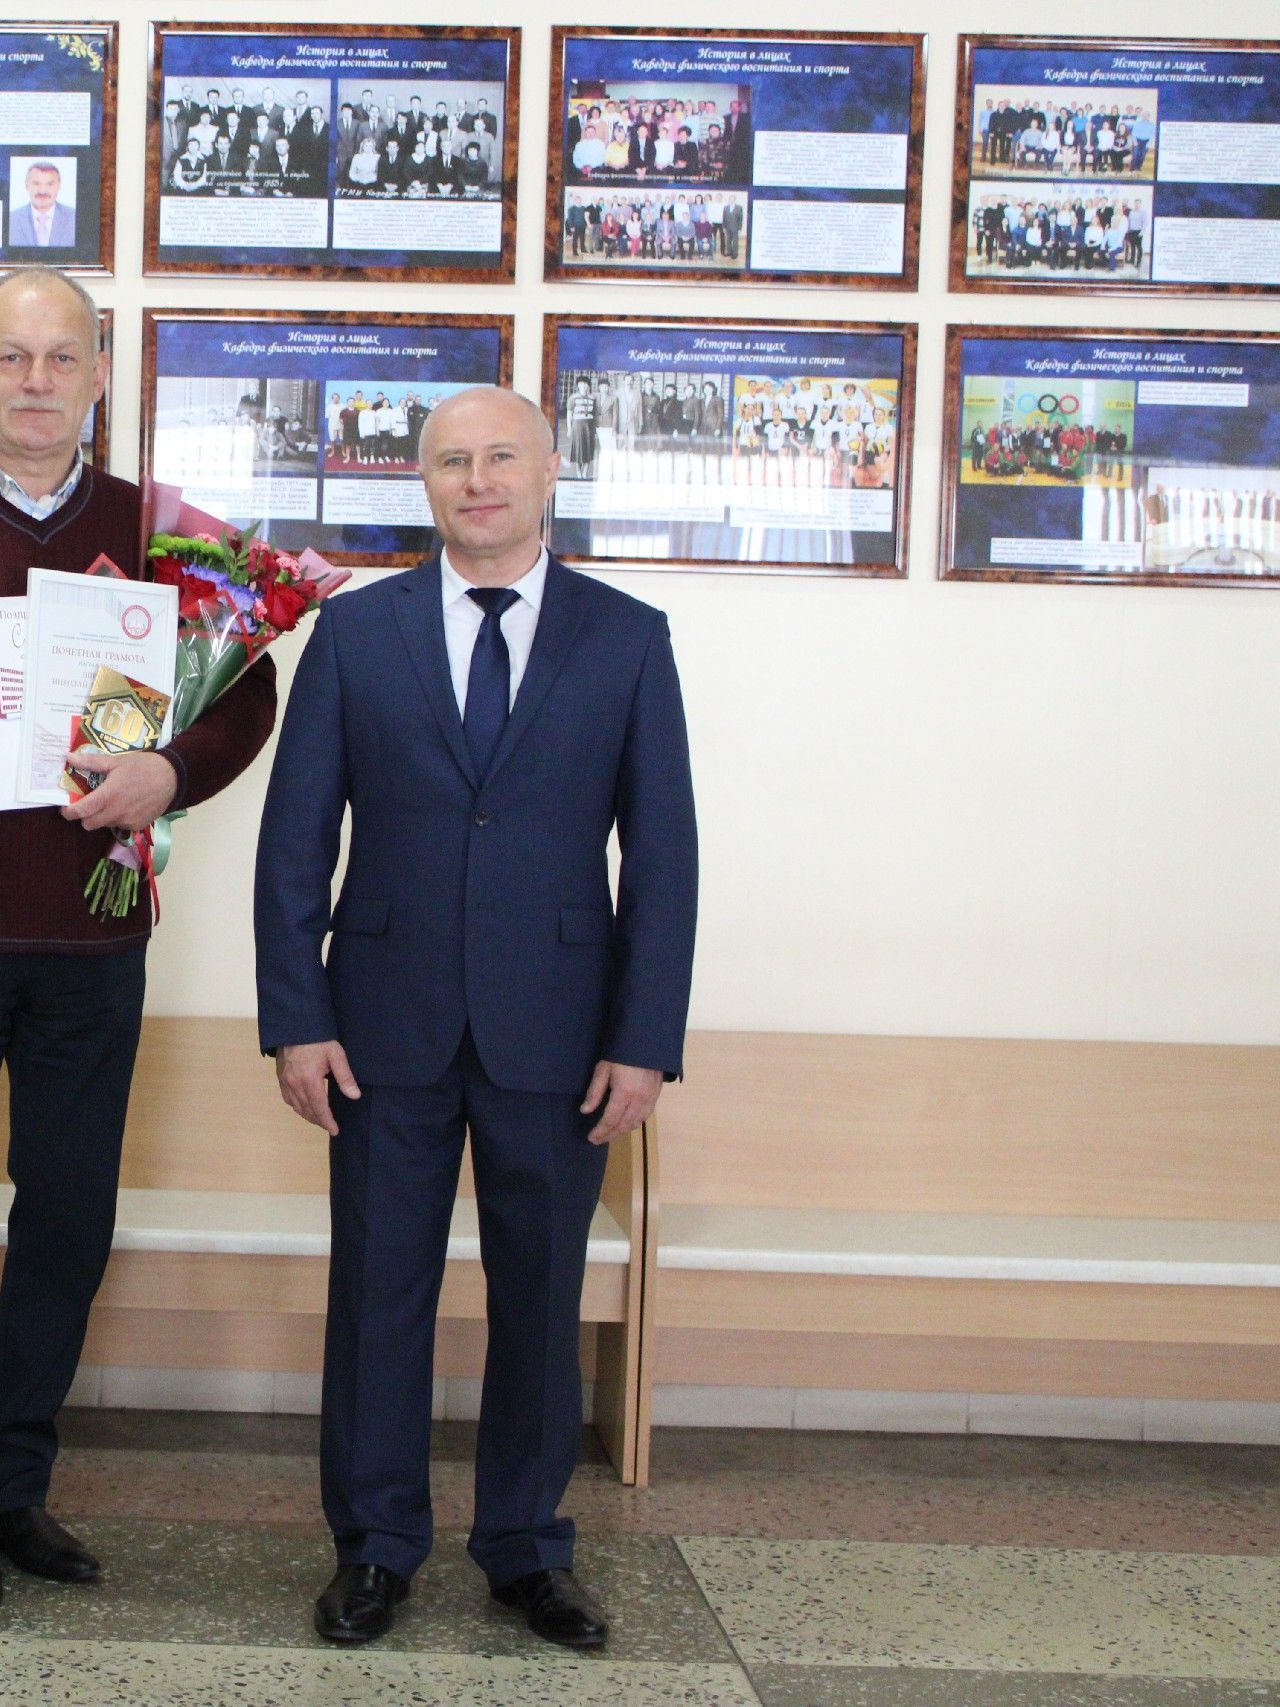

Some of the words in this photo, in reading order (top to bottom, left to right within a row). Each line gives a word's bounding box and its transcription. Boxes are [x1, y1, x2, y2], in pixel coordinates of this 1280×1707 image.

[0, 53, 6, 62] и
[8, 53, 45, 64] спорта
[296, 44, 345, 57] История
[347, 47, 353, 56] в
[355, 47, 389, 58] лицах
[697, 47, 746, 61] История
[749, 51, 755, 60] в
[757, 51, 791, 63] лицах
[230, 55, 274, 69] Кафедра
[276, 55, 338, 69] физического
[339, 58, 399, 68] воспитания
[402, 60, 408, 68] и
[410, 60, 448, 71] спорта
[632, 58, 676, 72] Кафедра
[677, 58, 740, 73] физического
[741, 63, 802, 73] воспитания
[804, 65, 811, 73] и
[813, 64, 849, 76] спорта
[1112, 57, 1161, 71] История
[1164, 60, 1170, 69] в
[1172, 60, 1207, 72] лицах
[1044, 68, 1088, 81] Кафедра
[1090, 70, 1152, 84] физического
[1154, 73, 1215, 83] воспитания
[1218, 74, 1224, 83] и
[1227, 74, 1264, 86] спорта
[287, 331, 336, 345] История
[339, 334, 344, 342] в
[346, 334, 380, 345] лицах
[693, 337, 742, 352] История
[745, 341, 750, 350] в
[753, 341, 787, 353] лицах
[222, 341, 265, 355] Кафедра
[268, 342, 329, 355] физического
[330, 346, 391, 356] воспитания
[393, 347, 399, 356] и
[401, 347, 438, 358] спорта
[1092, 349, 1142, 363] История
[1145, 352, 1151, 361] в
[1153, 352, 1186, 363] лицах
[628, 350, 672, 363] Кафедра
[674, 350, 736, 364] физического
[738, 354, 798, 364] воспитания
[800, 356, 806, 364] и
[809, 355, 845, 367] спорта
[1025, 359, 1069, 373] Кафедра
[1071, 360, 1133, 374] физического
[1135, 364, 1195, 374] воспитания
[1198, 366, 1204, 374] и
[1207, 365, 1243, 377] спорта
[52, 646, 100, 659] ПОЧЕТНАЯ
[105, 652, 146, 664] ГРАМОТА
[100, 699, 146, 743] 60
